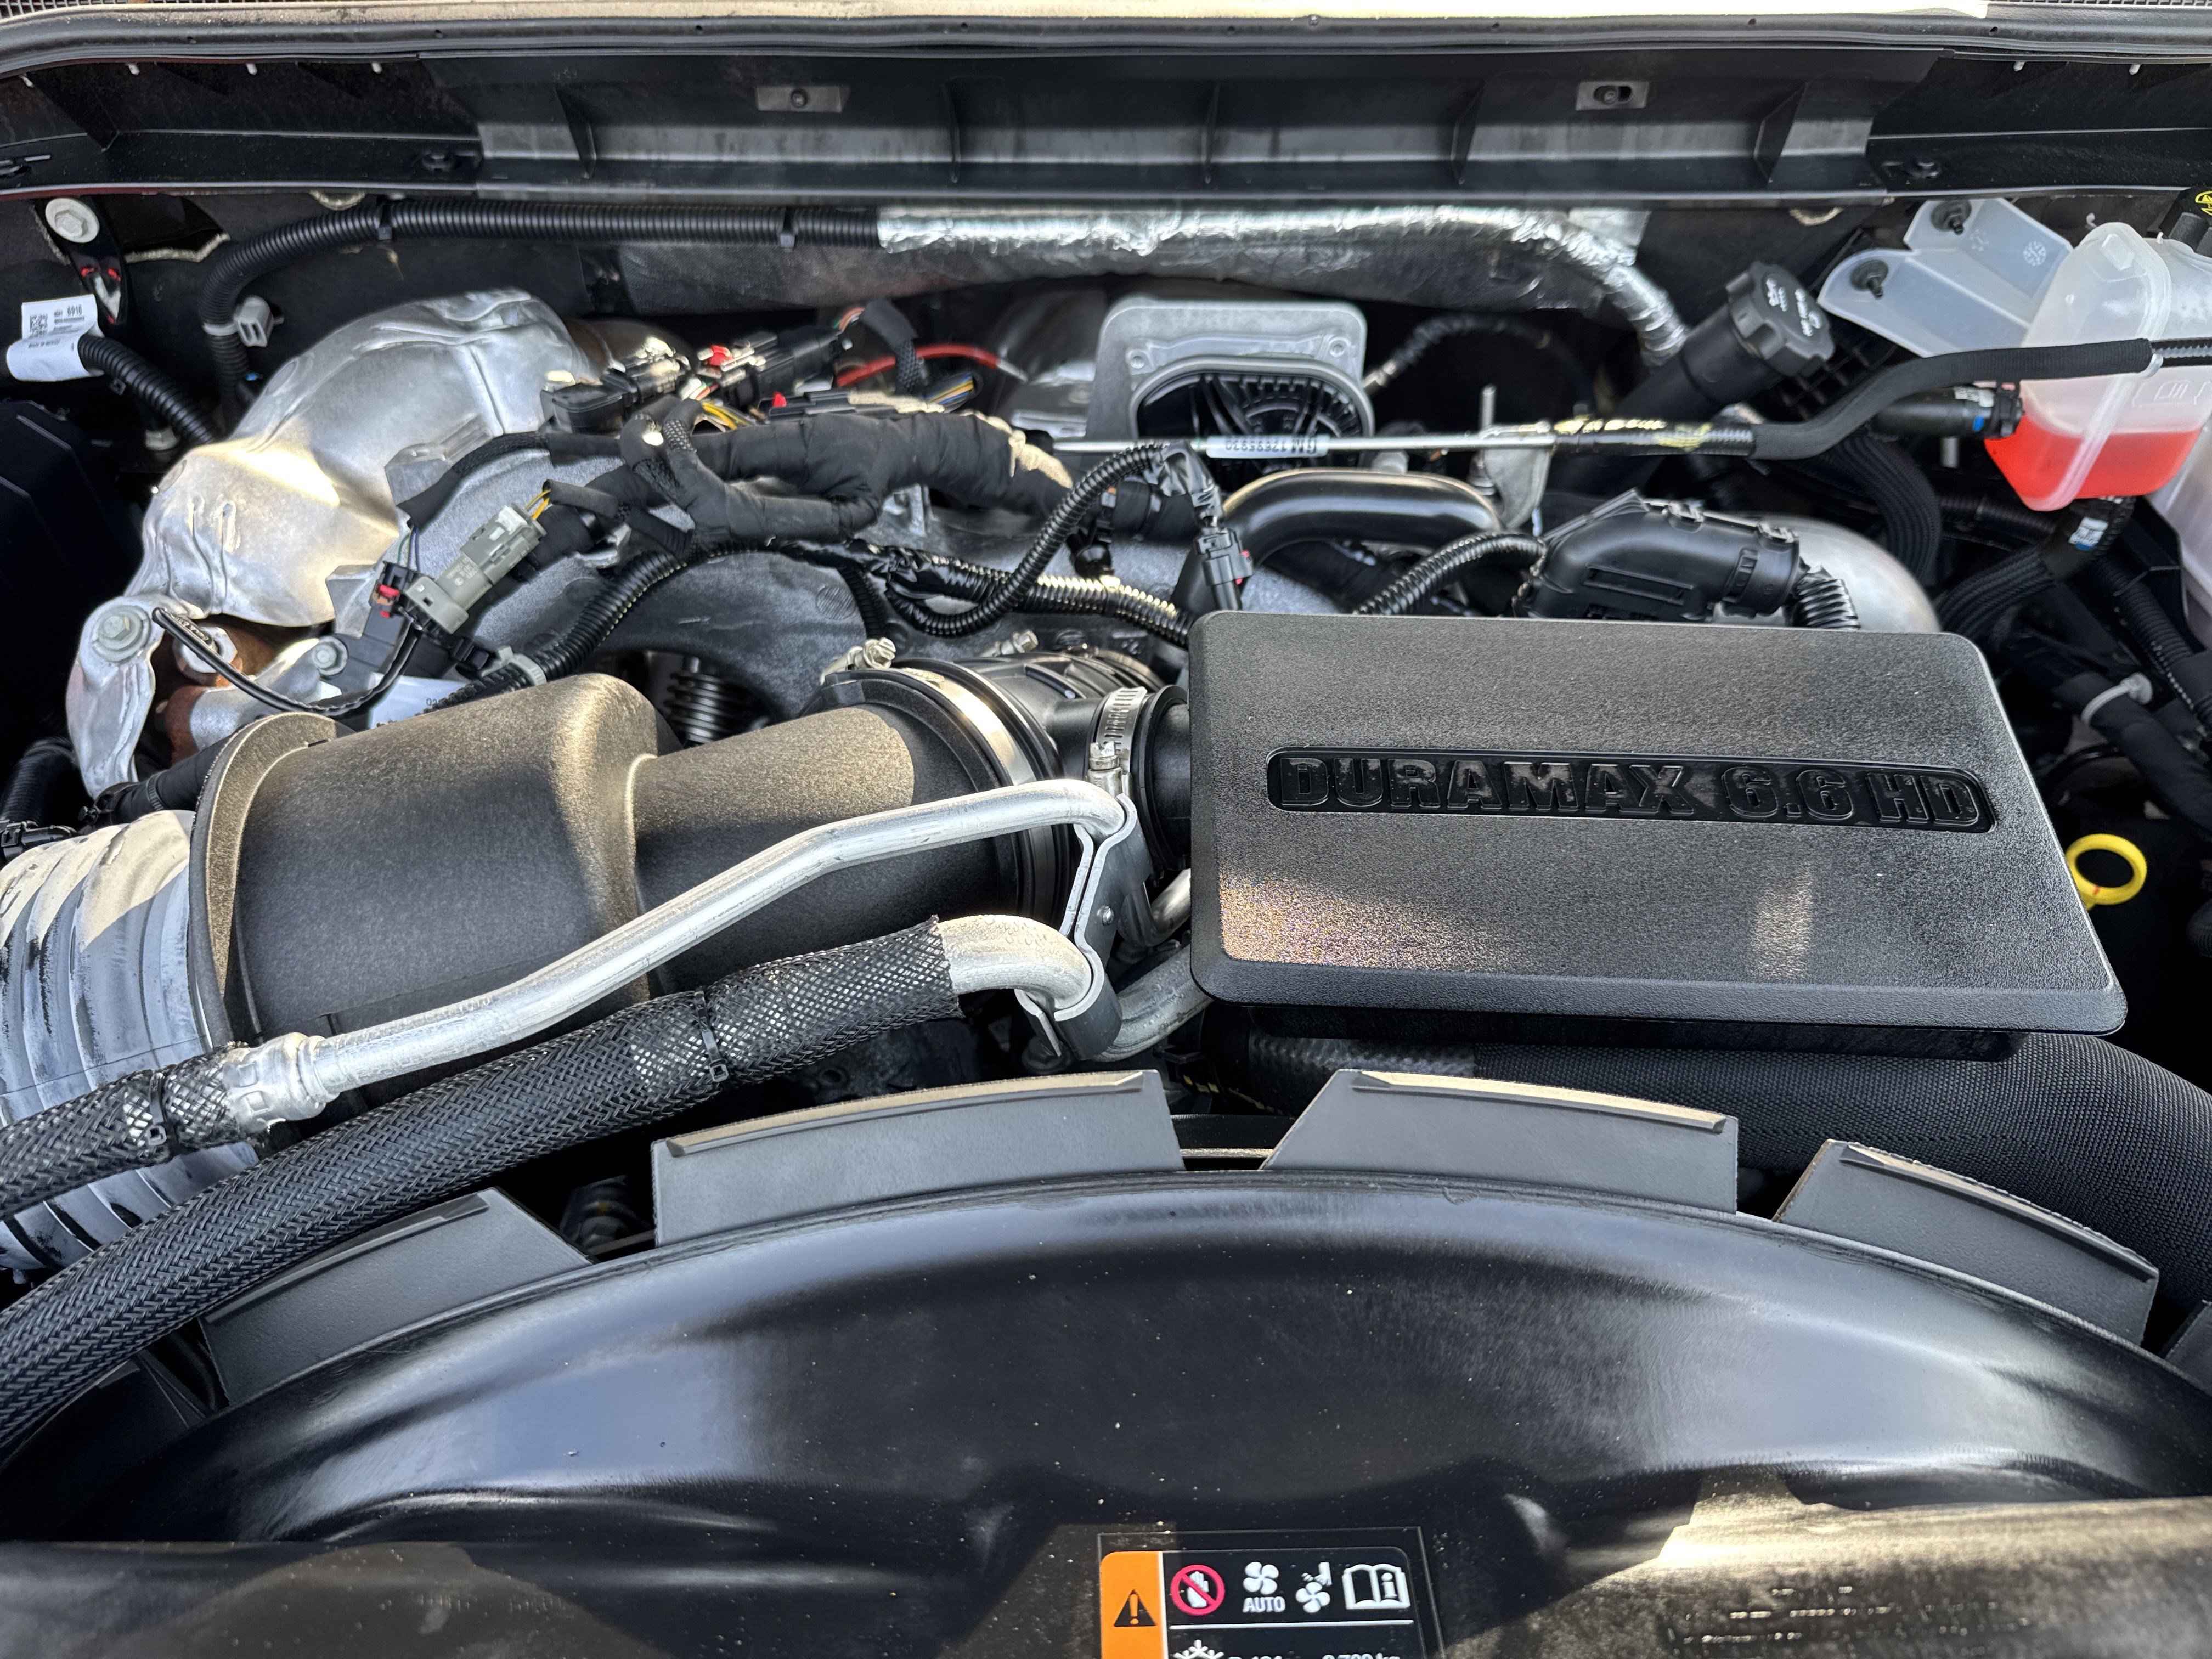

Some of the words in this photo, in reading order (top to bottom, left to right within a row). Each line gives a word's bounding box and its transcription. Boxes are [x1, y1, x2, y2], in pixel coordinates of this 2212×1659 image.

[1280, 757, 1695, 816] DURAMAX
[1720, 765, 1854, 821] 6.6
[1867, 771, 1980, 827] HD
[1242, 1596, 1286, 1613] AUTO
